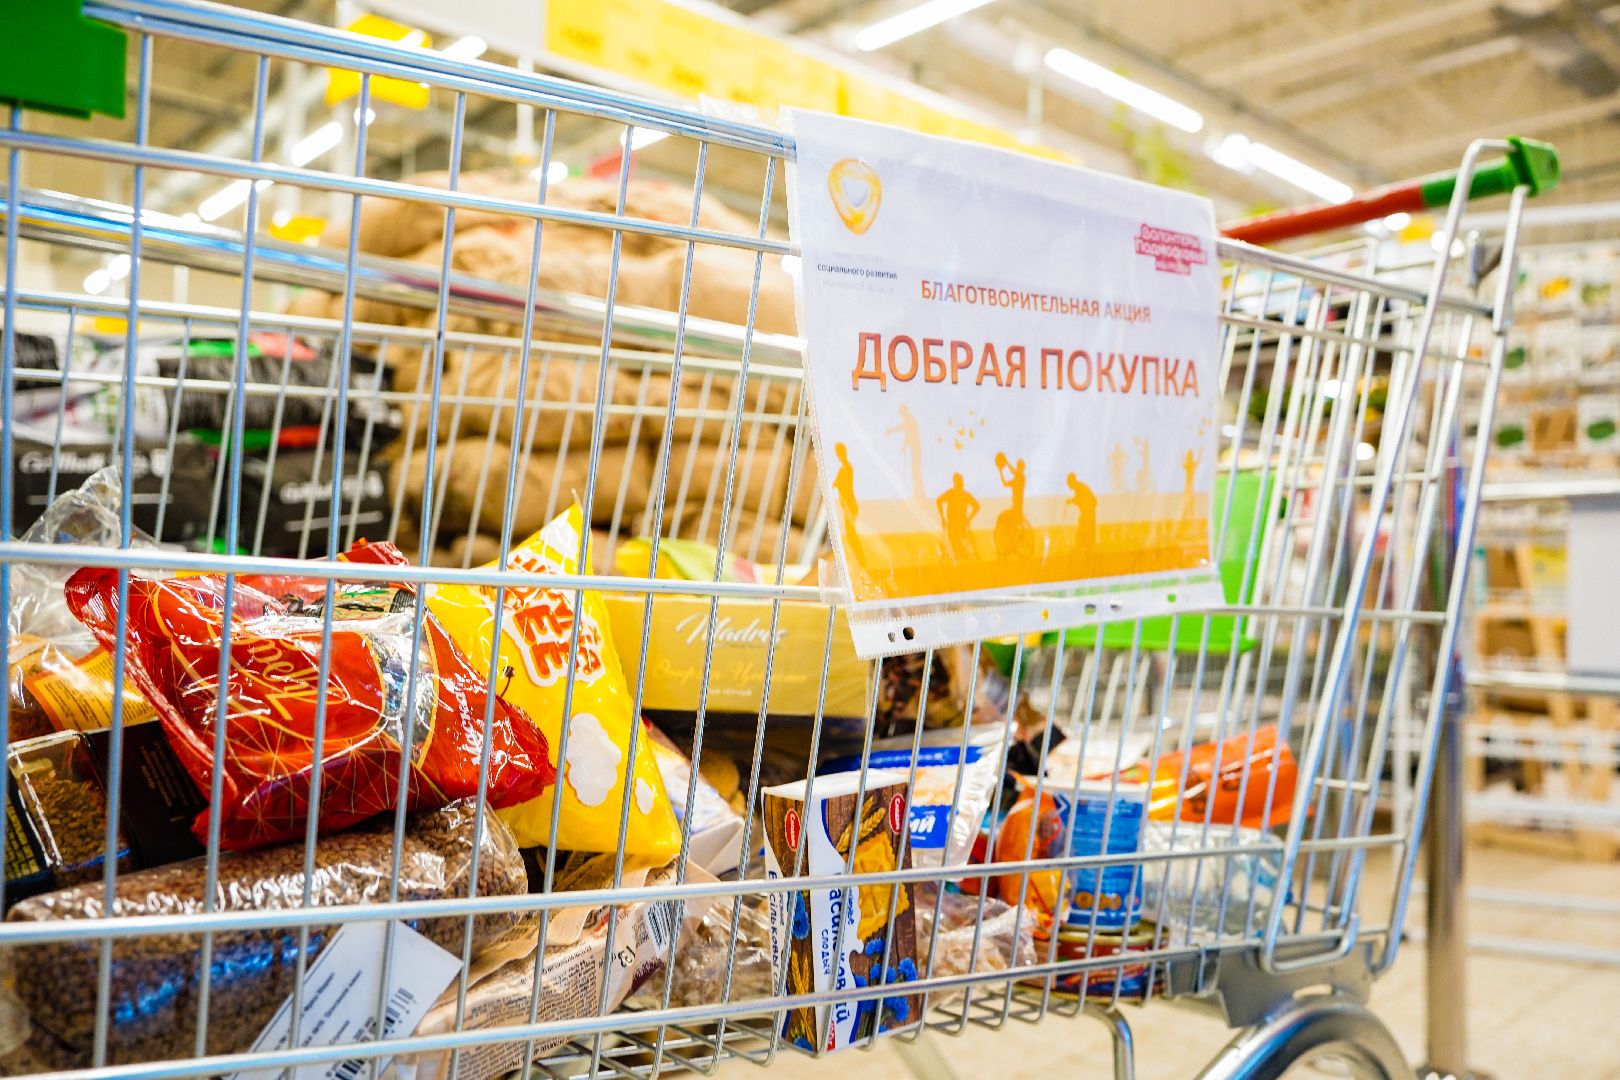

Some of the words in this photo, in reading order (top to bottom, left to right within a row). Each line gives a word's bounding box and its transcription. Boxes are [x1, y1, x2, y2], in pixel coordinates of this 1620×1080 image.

[817, 263, 865, 277] социального
[865, 269, 898, 280] развития
[920, 279, 1100, 318] БЛАГОТВОРИТЕЛЬНАЯ
[1104, 301, 1151, 324] АКЦИЯ
[852, 331, 1026, 392] ДОБРАЯ
[1040, 347, 1200, 397] ПОКУПКА
